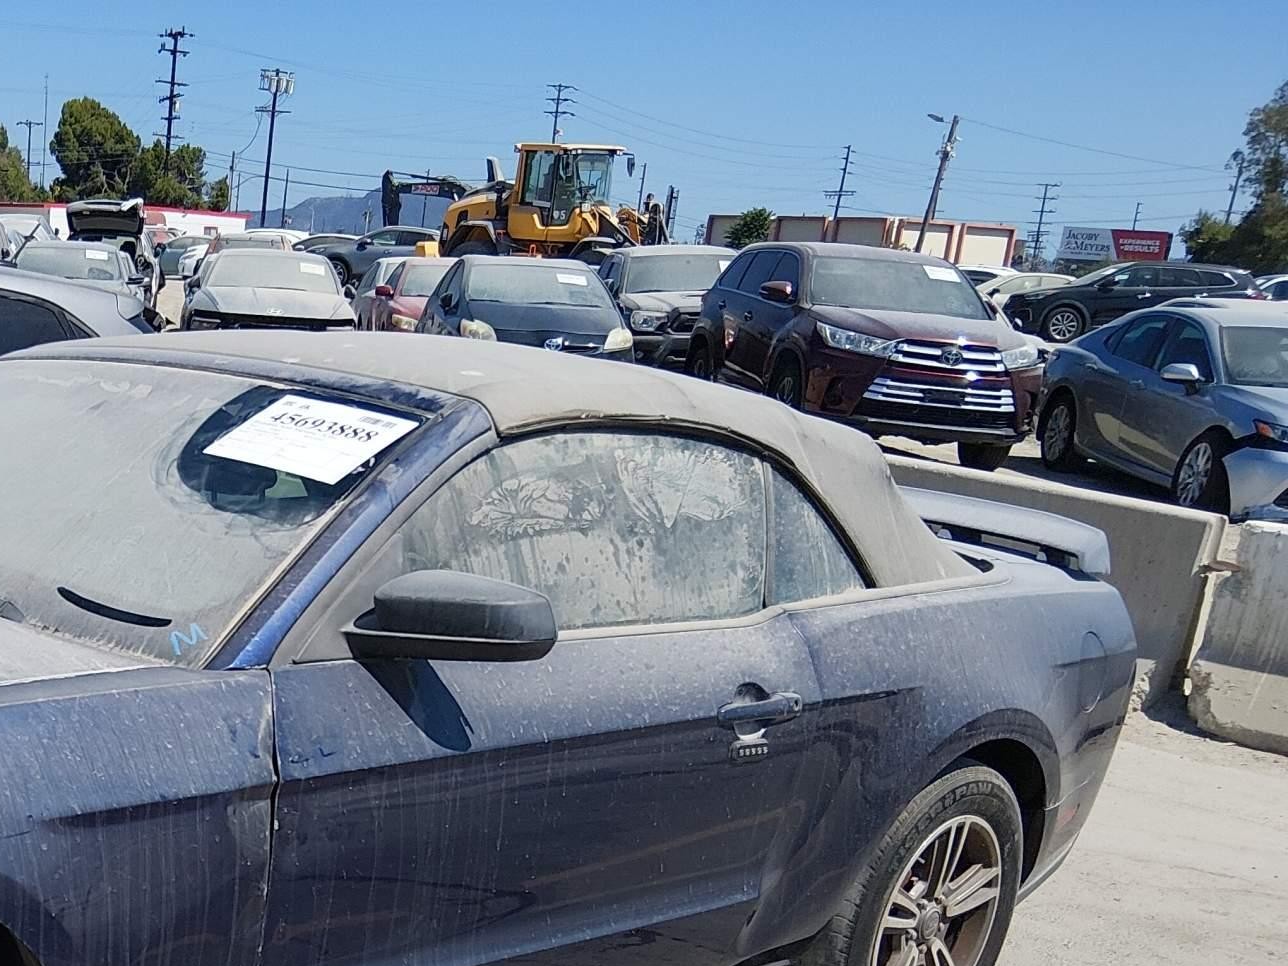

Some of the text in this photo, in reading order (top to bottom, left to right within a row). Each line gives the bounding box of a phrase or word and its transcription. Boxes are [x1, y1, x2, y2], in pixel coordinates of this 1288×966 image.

[1065, 230, 1100, 241] JACOBY
[1074, 241, 1111, 252] MEYERS
[271, 412, 379, 442] 45693888
[955, 782, 993, 801] PAW
